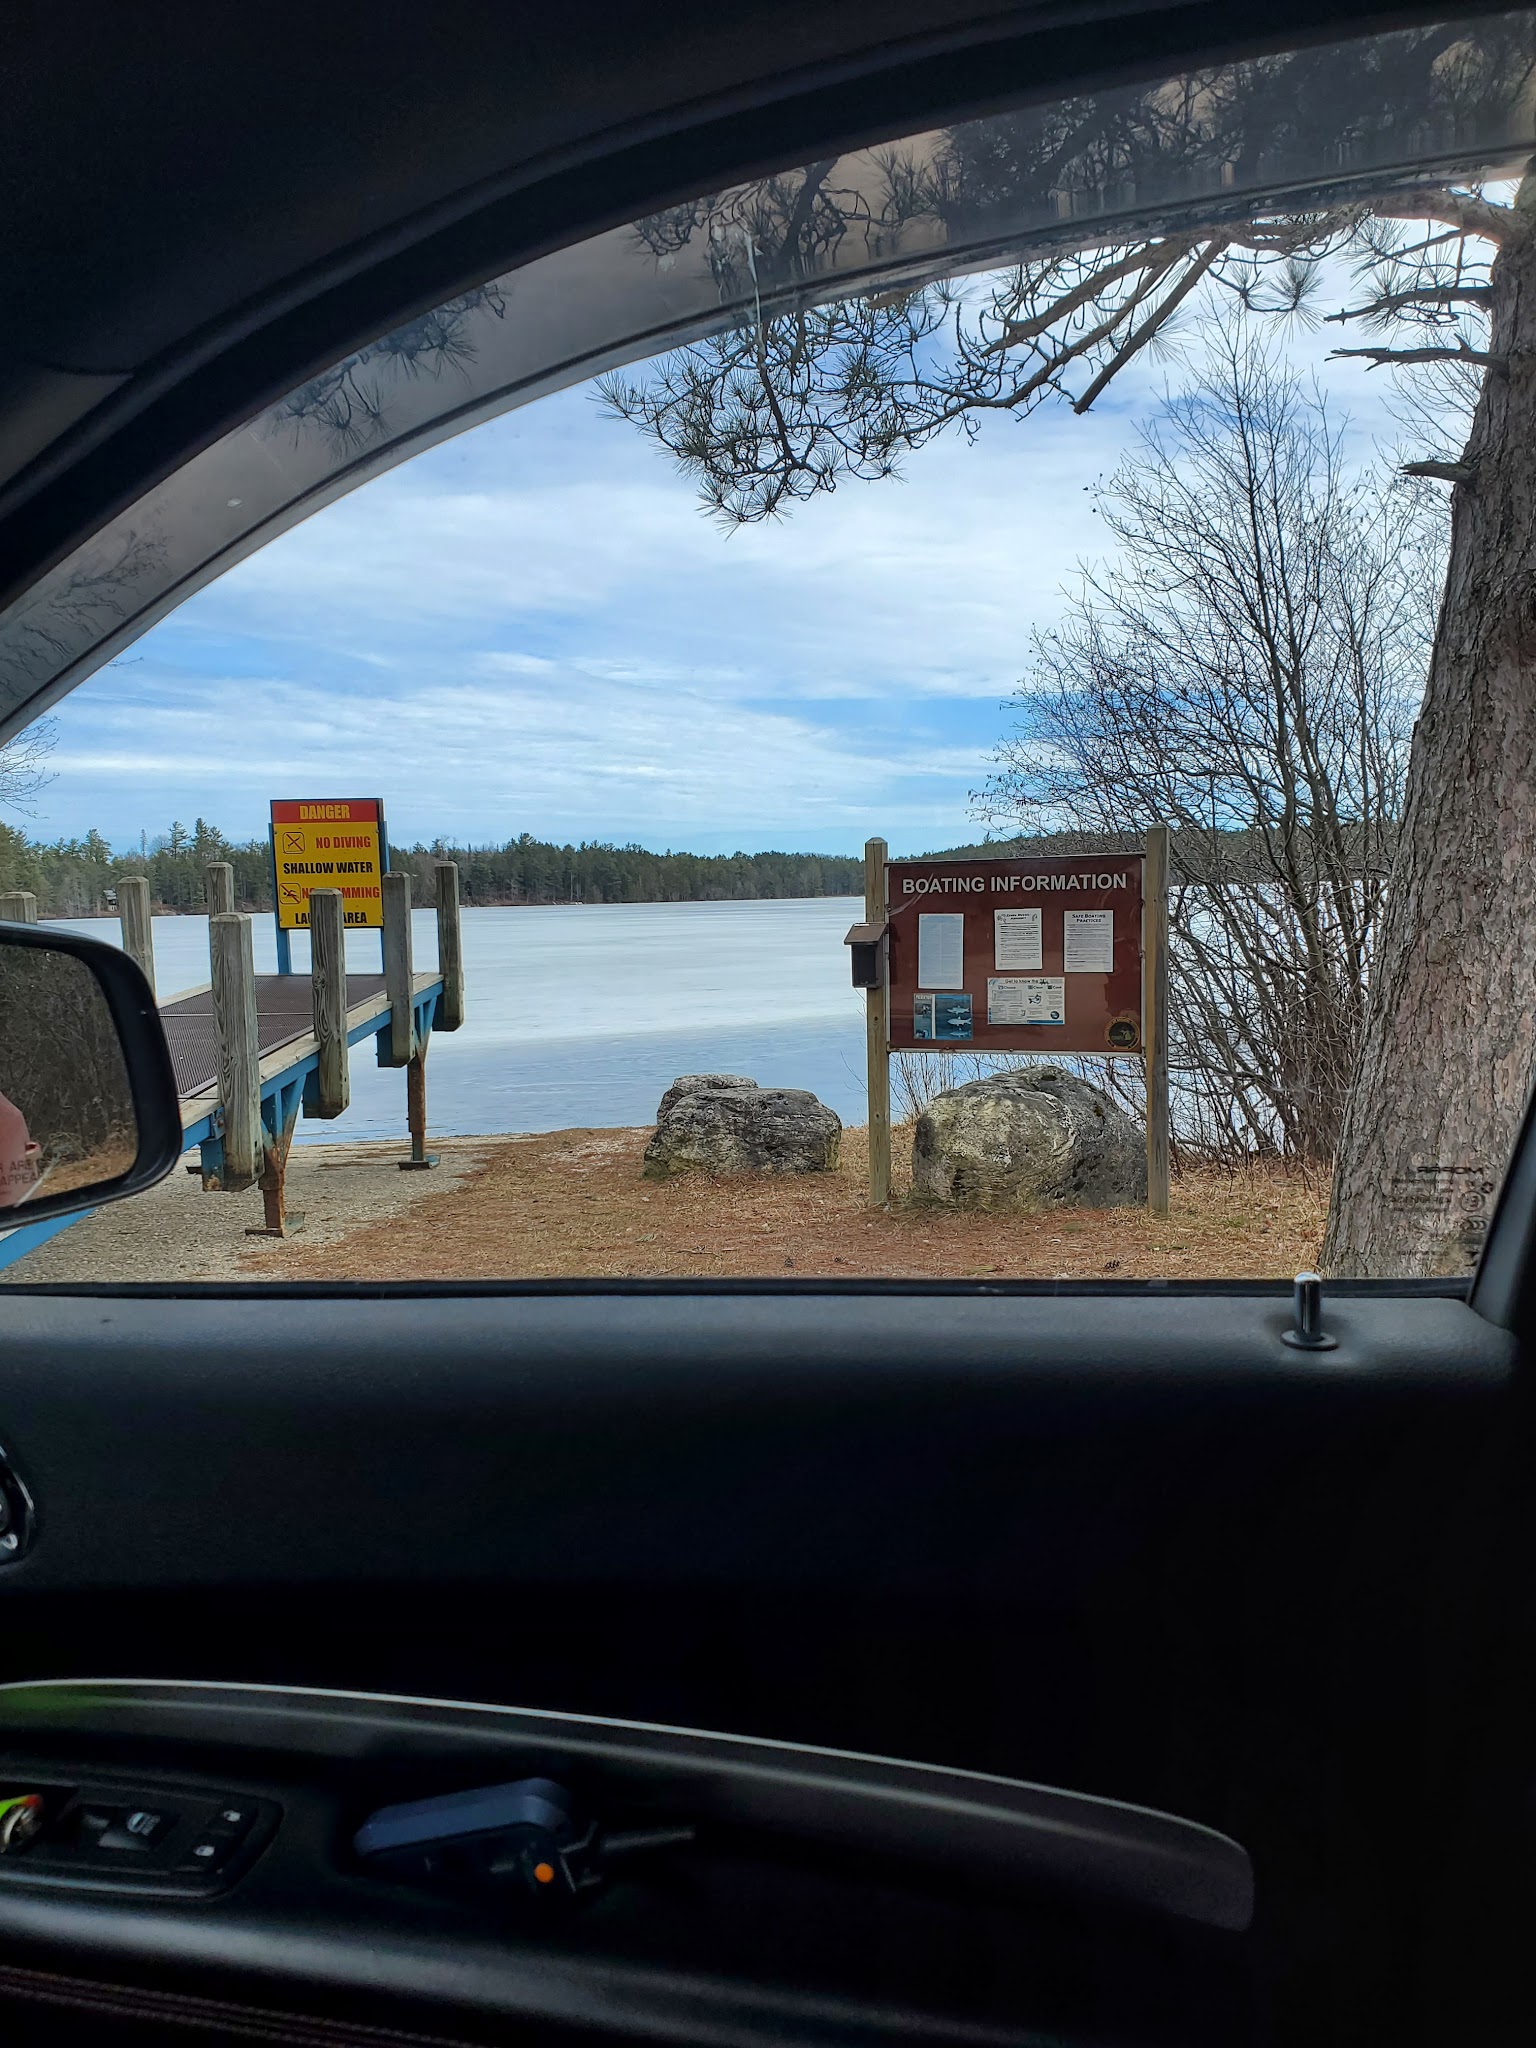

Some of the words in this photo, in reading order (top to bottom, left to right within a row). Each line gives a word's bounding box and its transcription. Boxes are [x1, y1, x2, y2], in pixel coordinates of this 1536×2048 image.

[299, 804, 350, 820] DANGER
[315, 836, 331, 849] NO
[333, 836, 371, 849] DIVING
[283, 862, 334, 874] SHALLOW
[336, 861, 373, 874] WATER
[902, 876, 985, 894] BOATING
[990, 872, 1127, 892] INFORMATION
